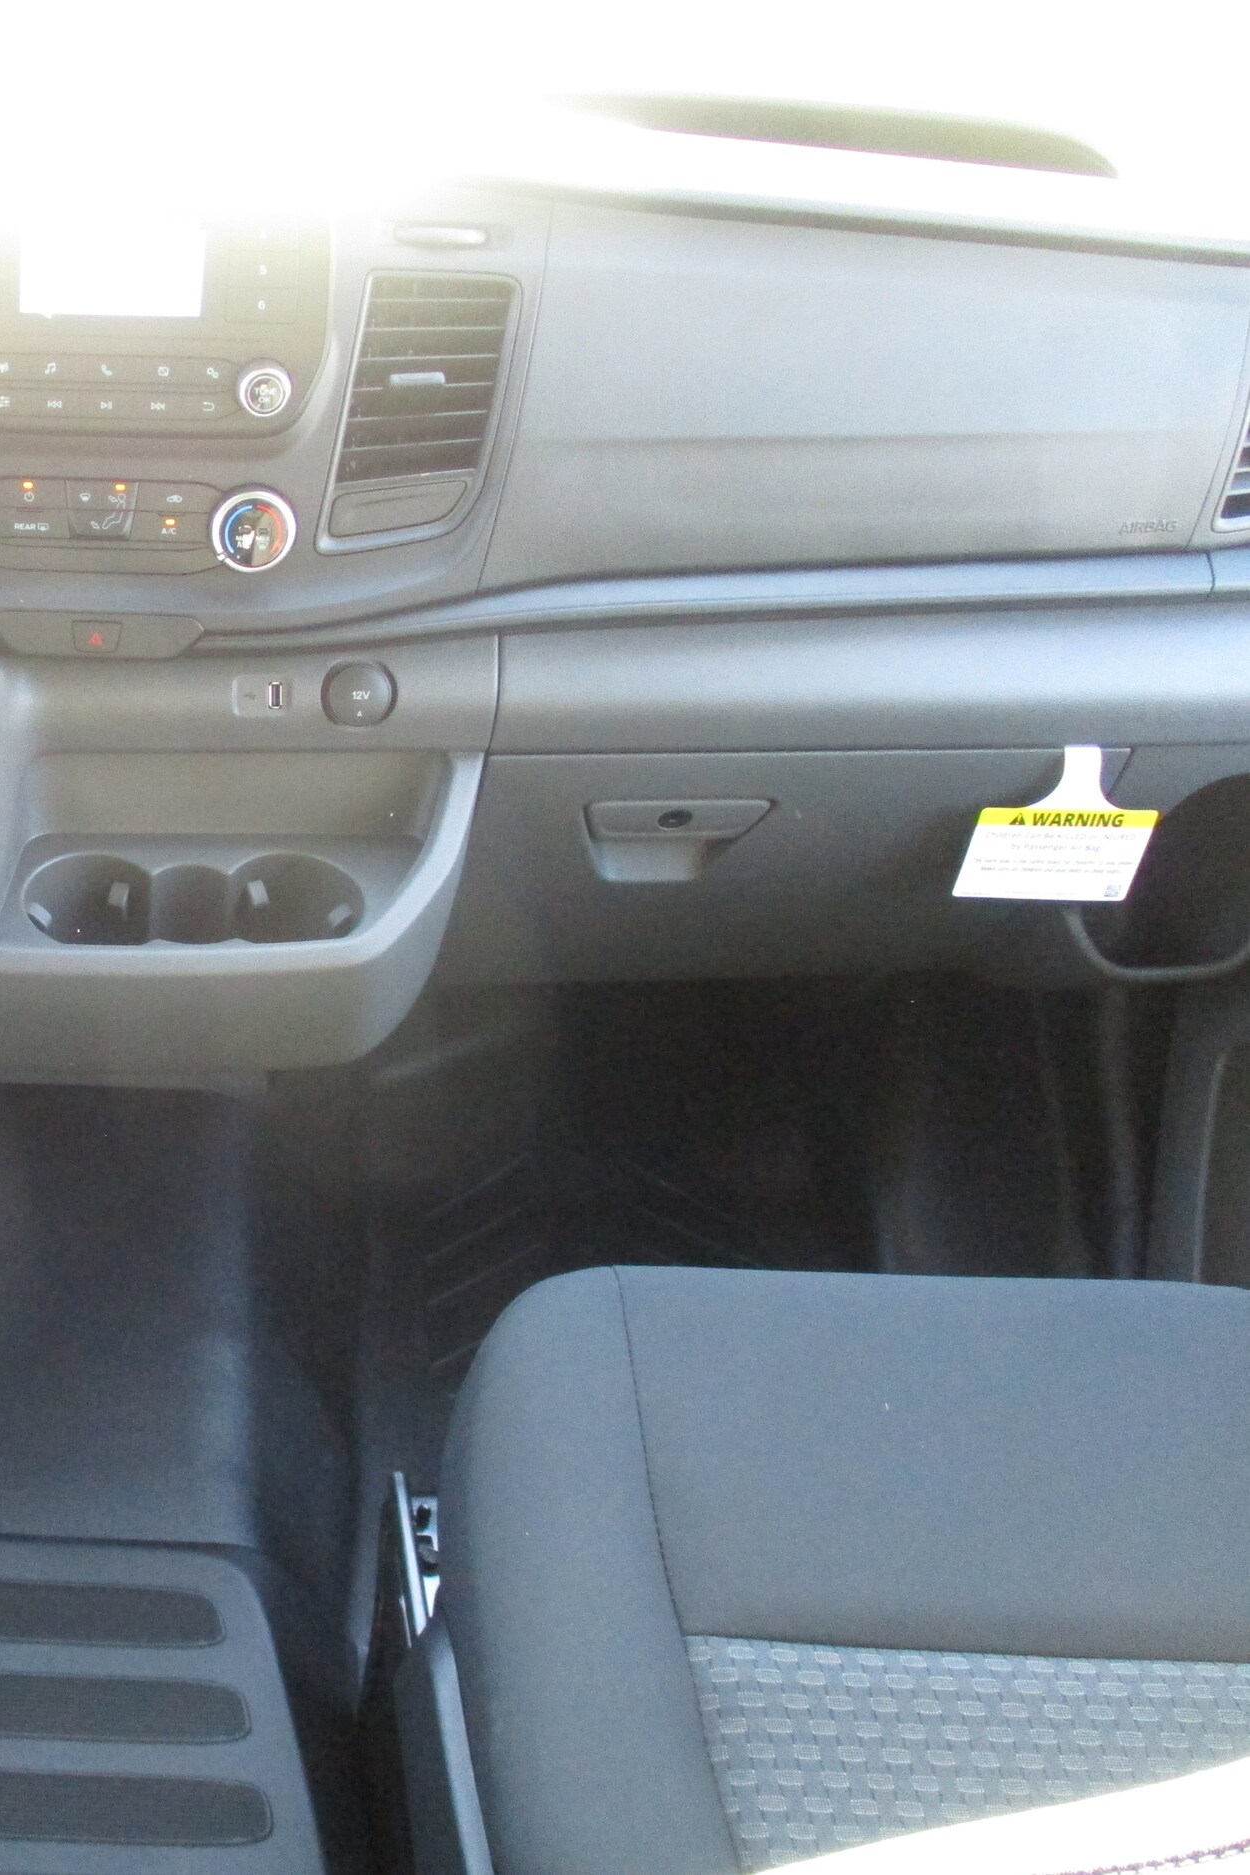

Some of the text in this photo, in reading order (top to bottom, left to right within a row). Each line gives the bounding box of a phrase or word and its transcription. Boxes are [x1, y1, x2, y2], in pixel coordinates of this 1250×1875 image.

[161, 527, 177, 535] A/C
[1118, 519, 1178, 535] AIRBAG
[352, 690, 371, 700] 12V
[1031, 813, 1125, 828] WARNING
